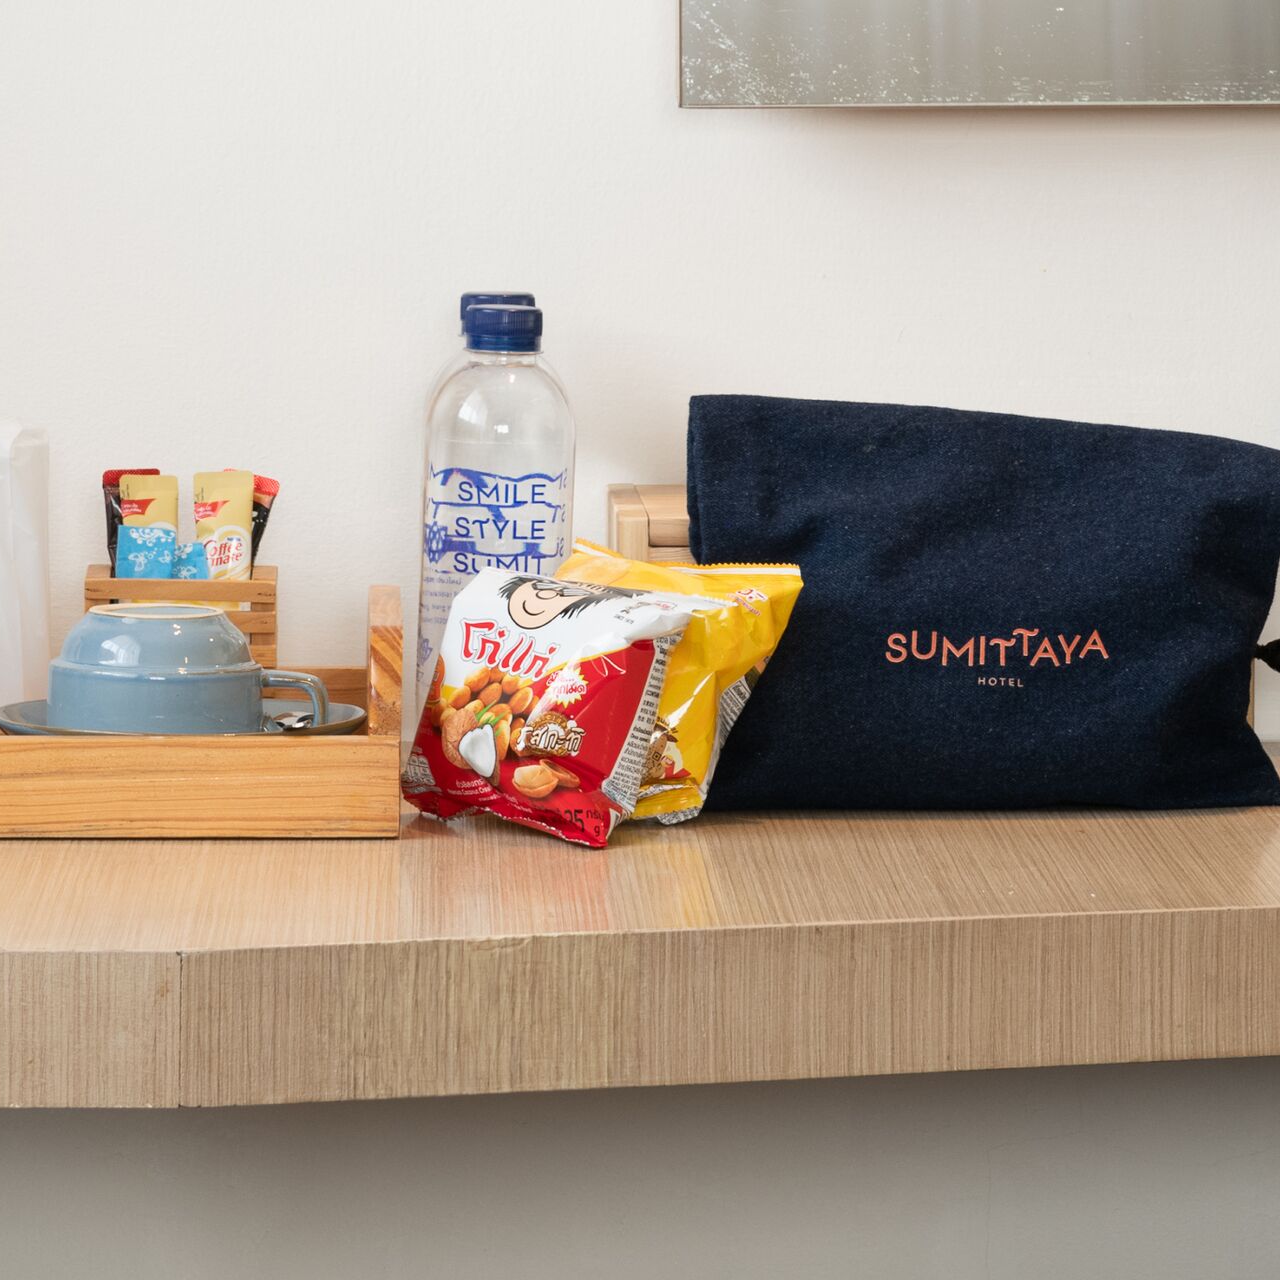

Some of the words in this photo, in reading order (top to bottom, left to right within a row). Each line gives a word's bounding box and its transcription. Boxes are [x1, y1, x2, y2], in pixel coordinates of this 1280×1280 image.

[457, 481, 547, 505] SMILE
[455, 517, 546, 540] STYLE
[453, 552, 546, 575] SUMIT
[885, 628, 1110, 667] SUMITTAYA
[978, 677, 1024, 688] HOTEL
